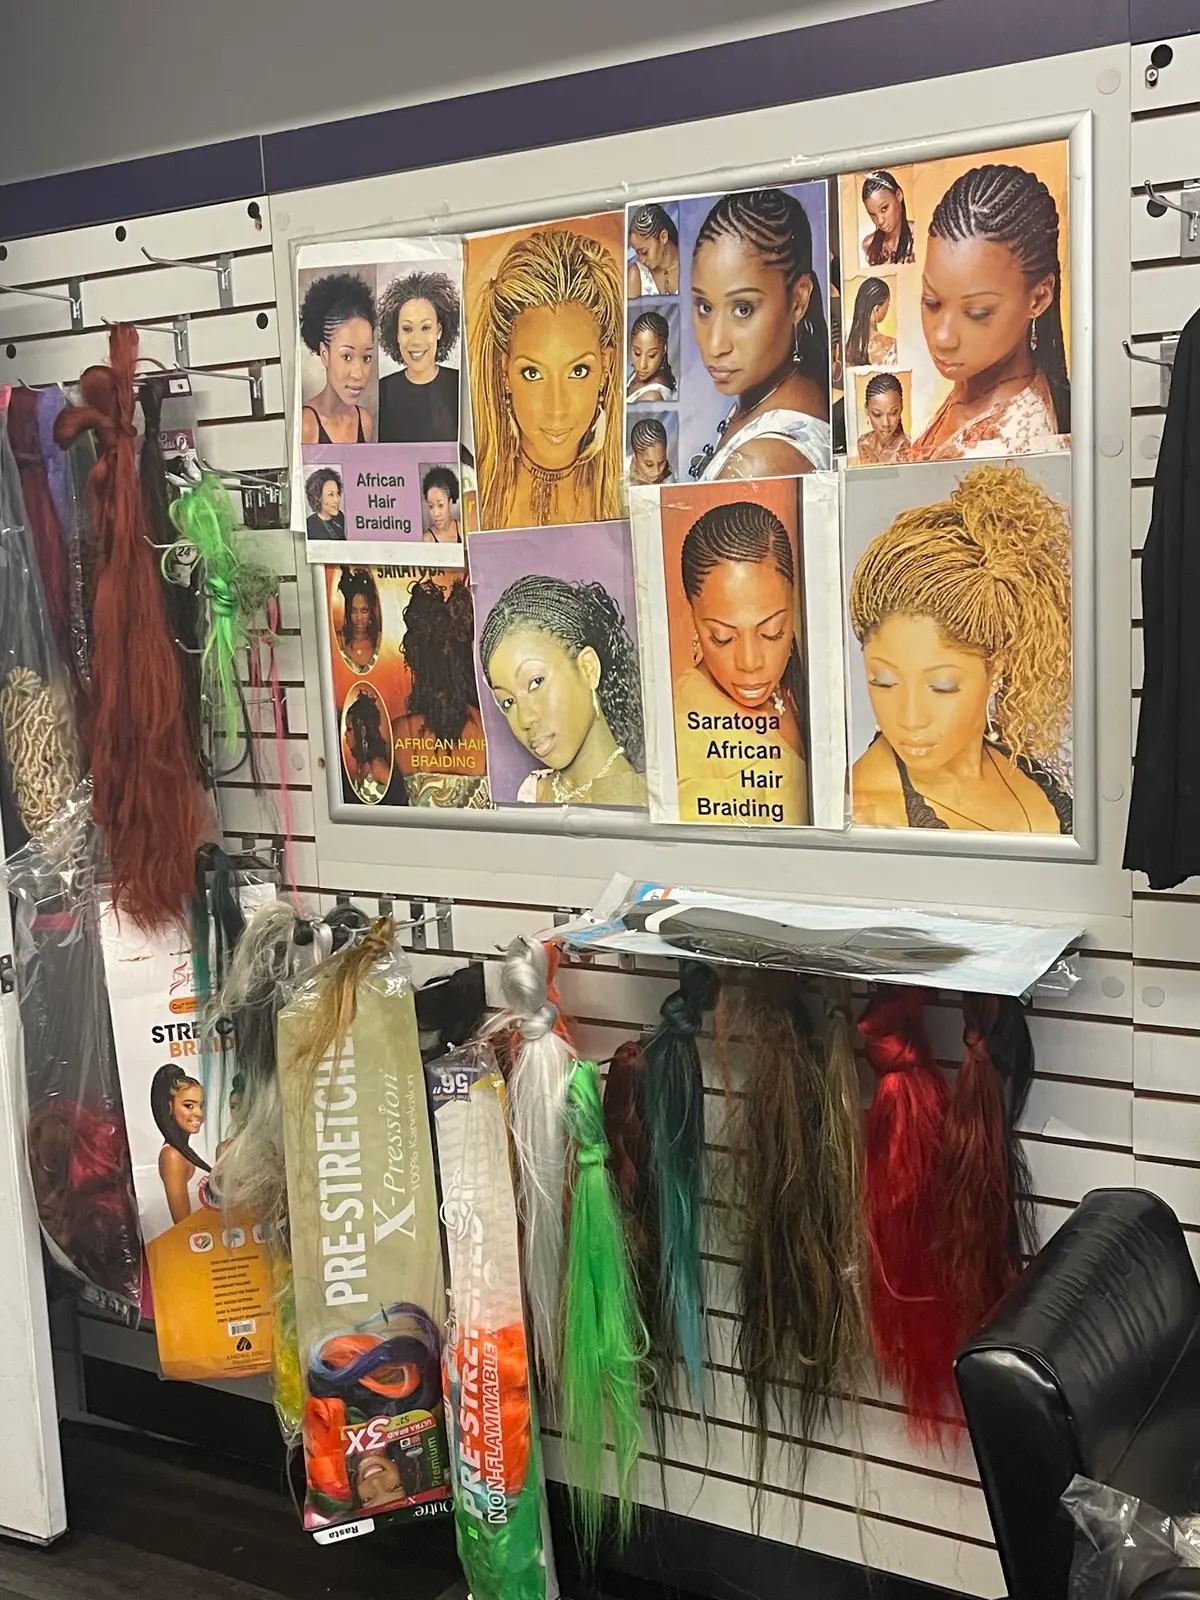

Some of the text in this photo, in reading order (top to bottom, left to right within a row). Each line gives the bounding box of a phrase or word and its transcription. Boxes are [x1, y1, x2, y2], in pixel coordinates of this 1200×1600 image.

[357, 472, 405, 487] African
[368, 494, 396, 508] Hair
[356, 515, 411, 533] Braiding
[687, 711, 780, 735] Saratoga
[394, 738, 453, 750] AFRICAN
[706, 740, 781, 759] African
[411, 755, 476, 768] BRAIDING
[740, 769, 783, 788] Hair
[697, 797, 784, 822] Braiding
[314, 1030, 368, 1307] PRE-STRETCHE
[372, 1072, 417, 1245] X-Pression
[409, 1150, 420, 1191] 100%
[345, 1418, 390, 1455] 3X
[387, 1418, 433, 1439] ULTRA BRAID
[482, 1341, 507, 1524] NON-FLAMMABLE
[427, 1436, 442, 1487] Premium
[414, 1500, 455, 1517] Outre
[328, 1525, 359, 1539] Rasta
